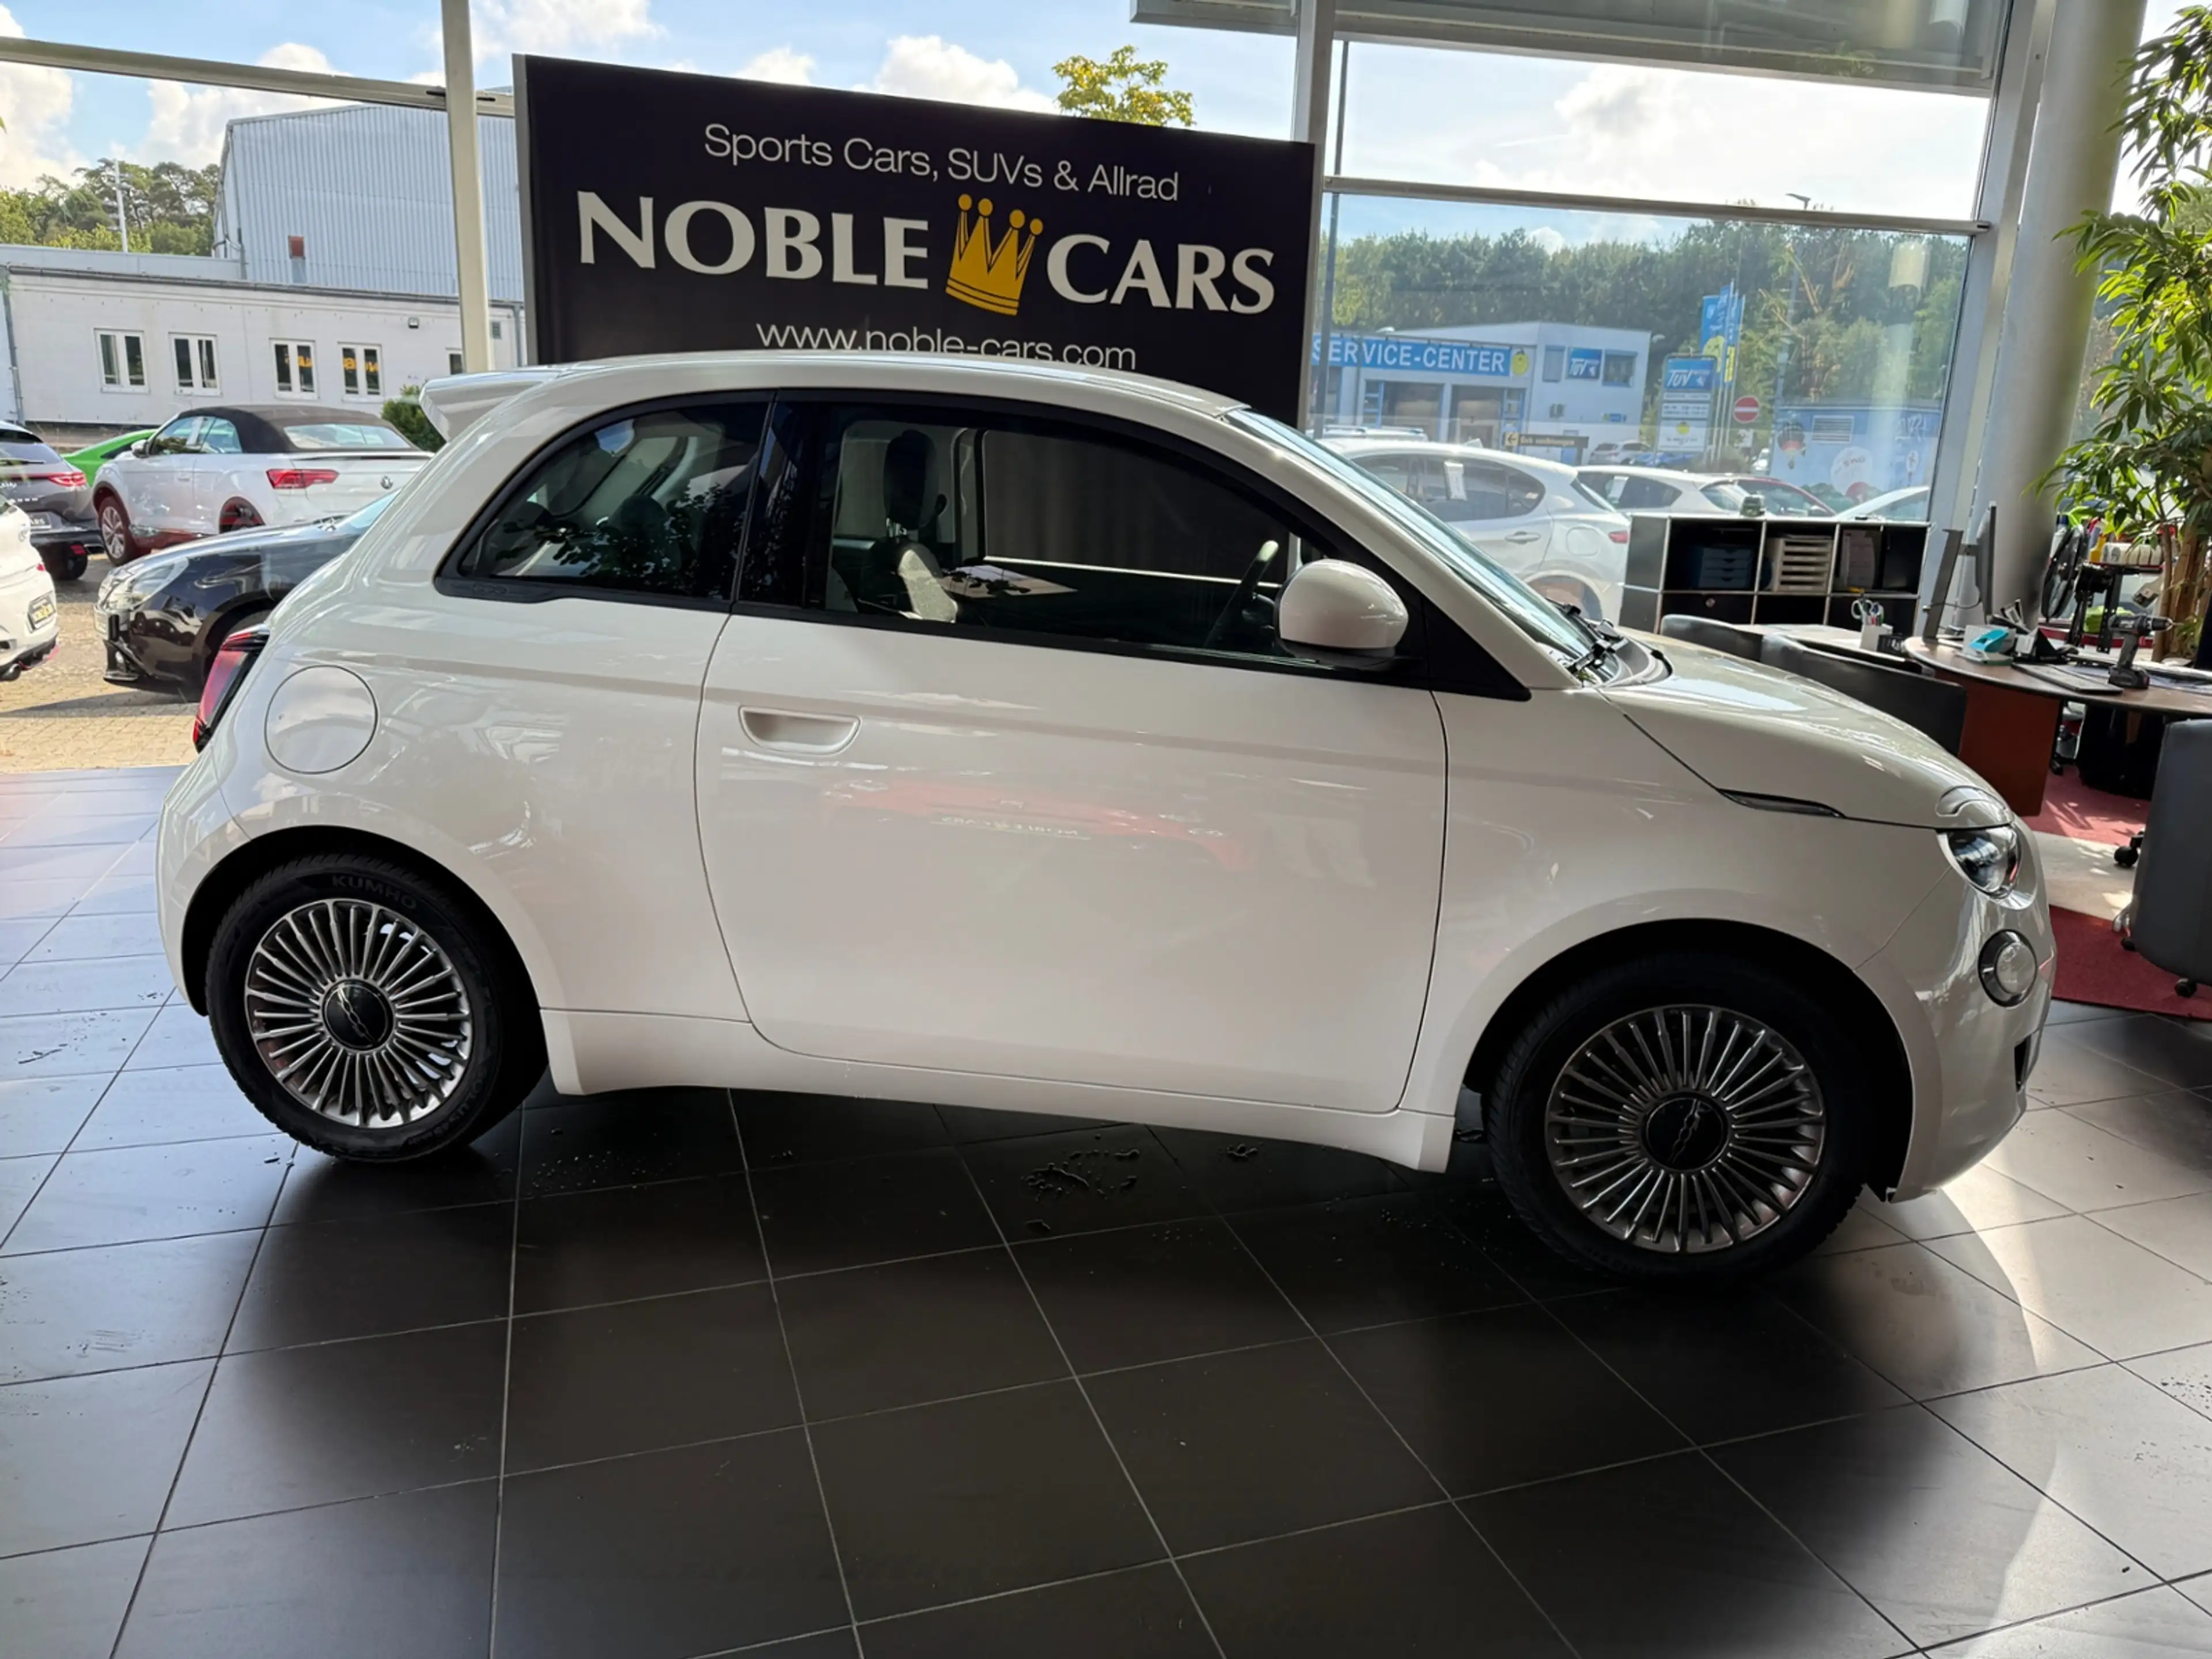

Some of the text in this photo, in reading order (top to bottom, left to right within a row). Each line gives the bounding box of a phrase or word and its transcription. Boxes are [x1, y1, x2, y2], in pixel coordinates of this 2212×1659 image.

[704, 124, 1178, 200] Sports Cars, SUVs & Allrad
[577, 191, 1275, 314] NOBLE CARS
[1312, 339, 1505, 373] SERVICE-CENTER
[331, 875, 417, 909] KUMHO
